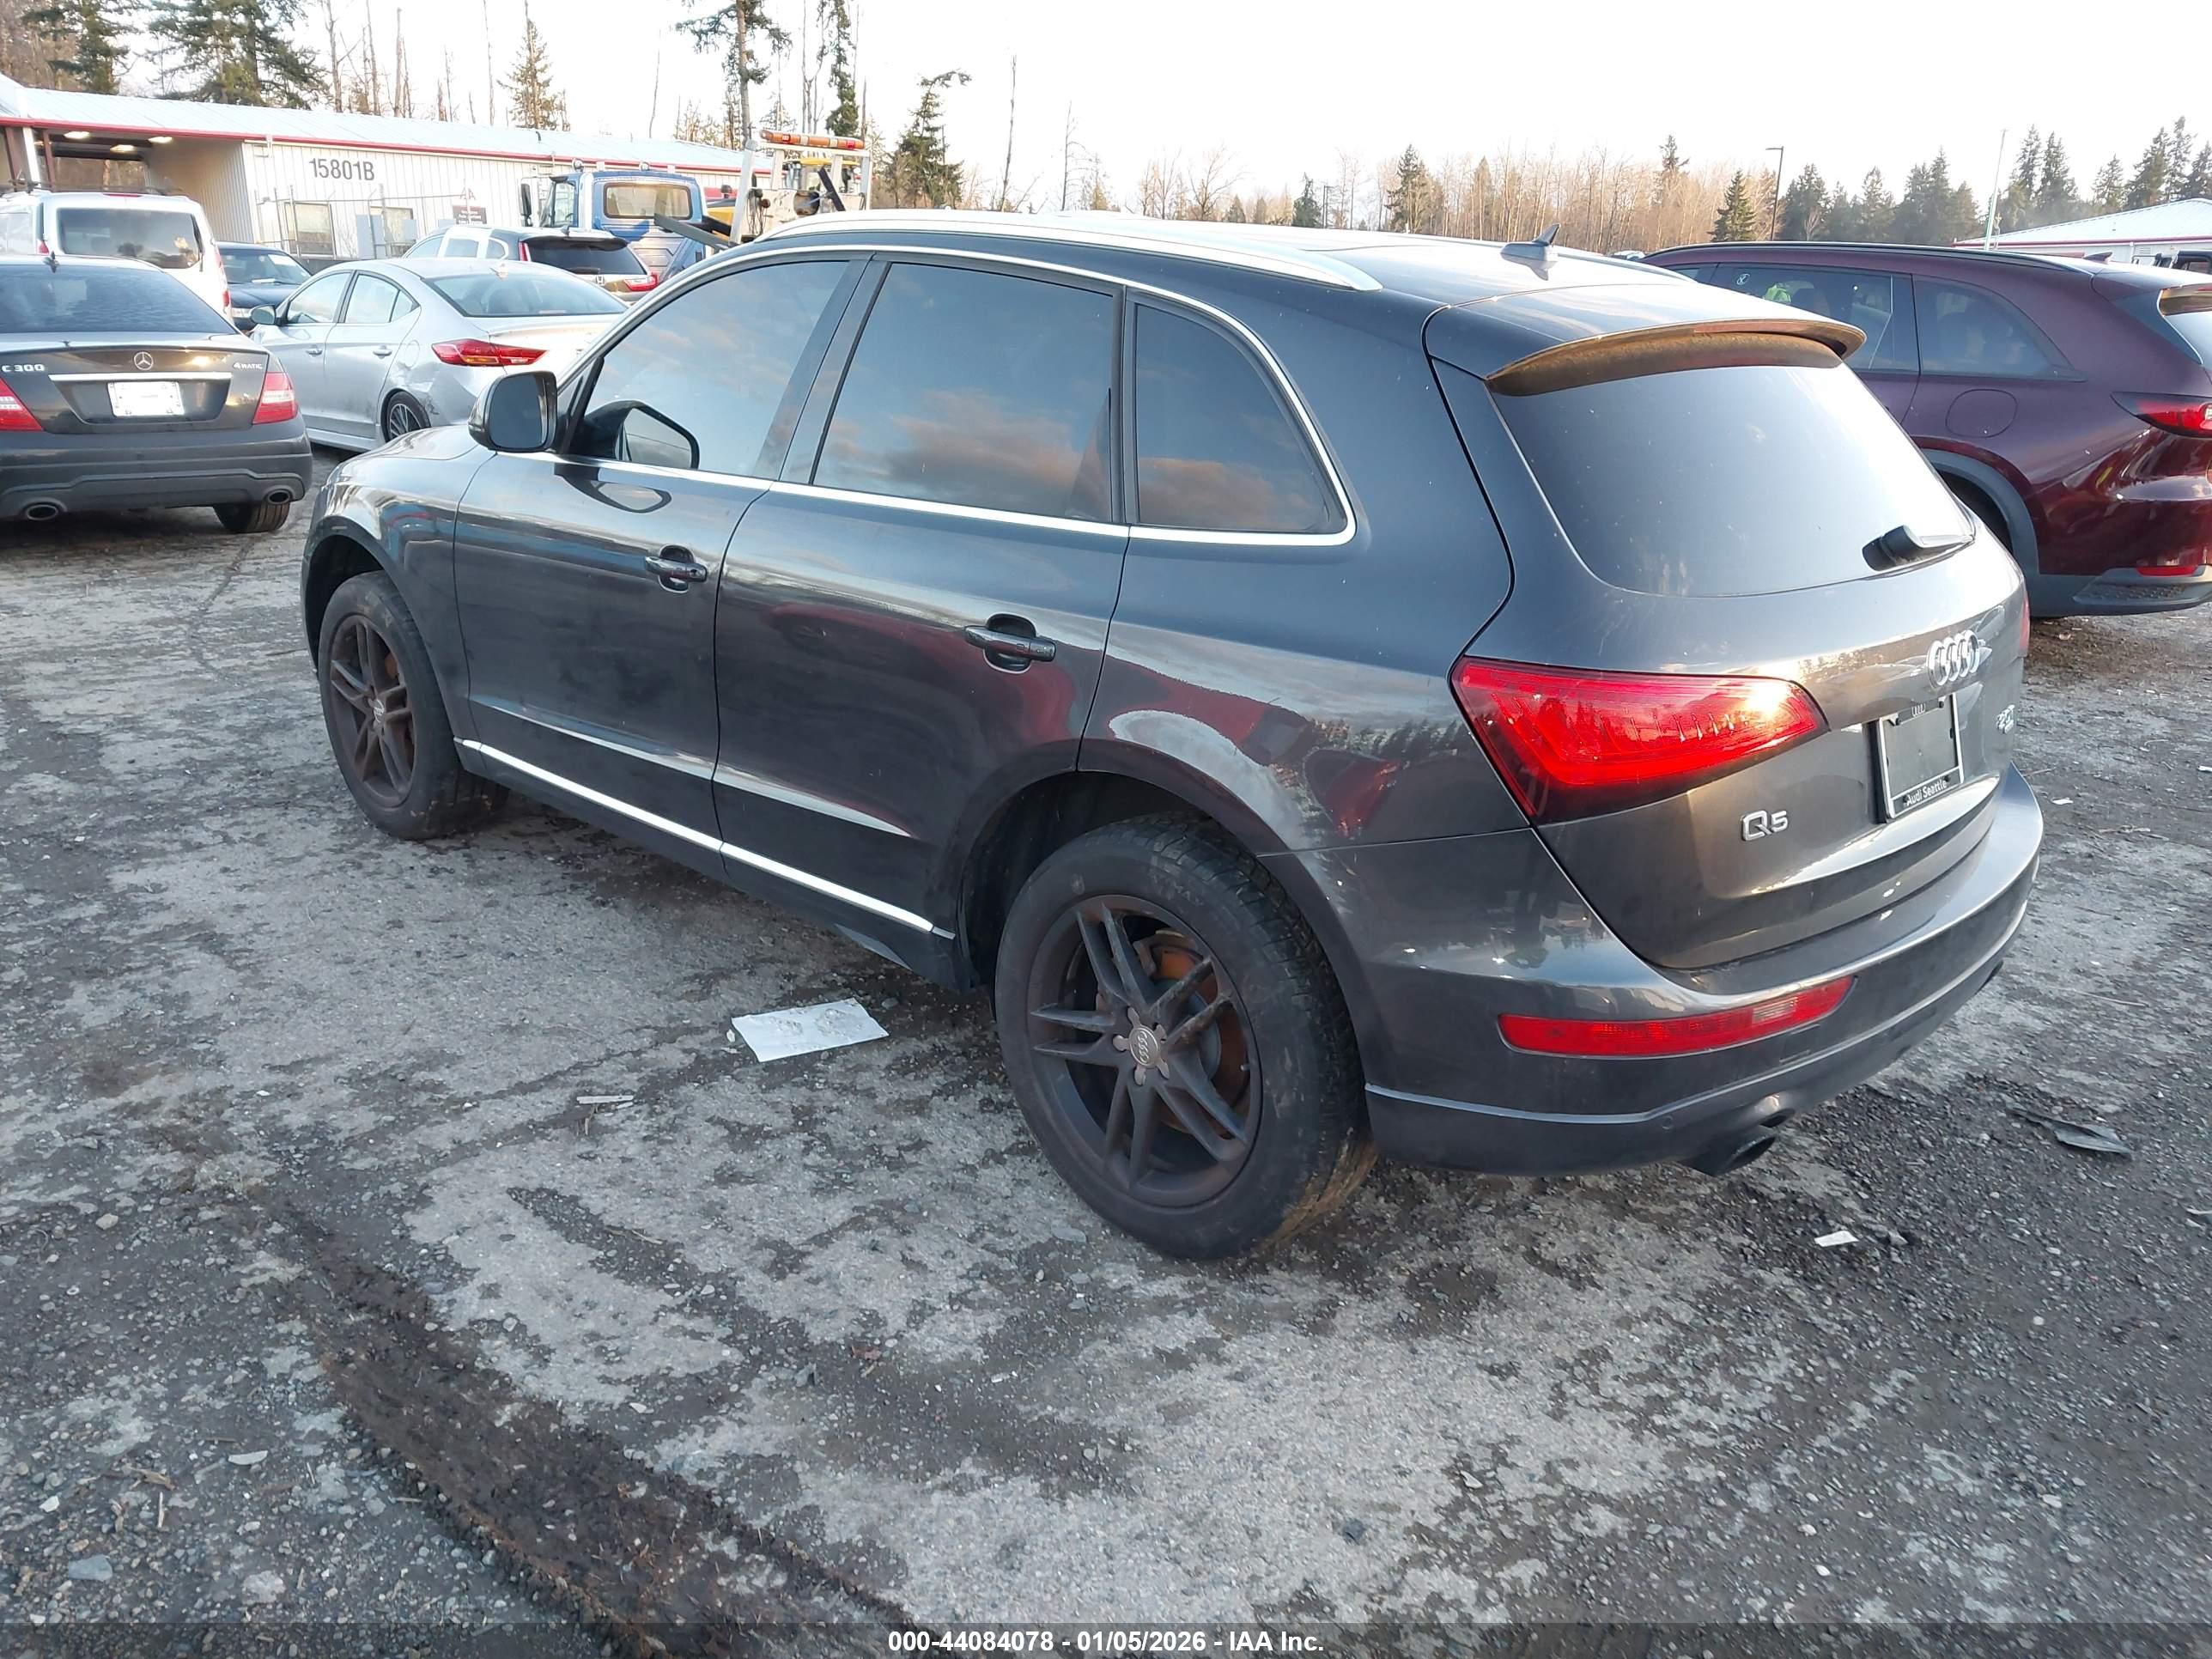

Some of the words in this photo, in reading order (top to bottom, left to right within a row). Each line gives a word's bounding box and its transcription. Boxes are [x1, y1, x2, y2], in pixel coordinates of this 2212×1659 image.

[309, 158, 375, 180] 15801B
[14, 363, 46, 372] 300
[1906, 788, 1923, 807] Audi
[1923, 779, 1948, 799] Seattle
[1740, 810, 1789, 841] Q5
